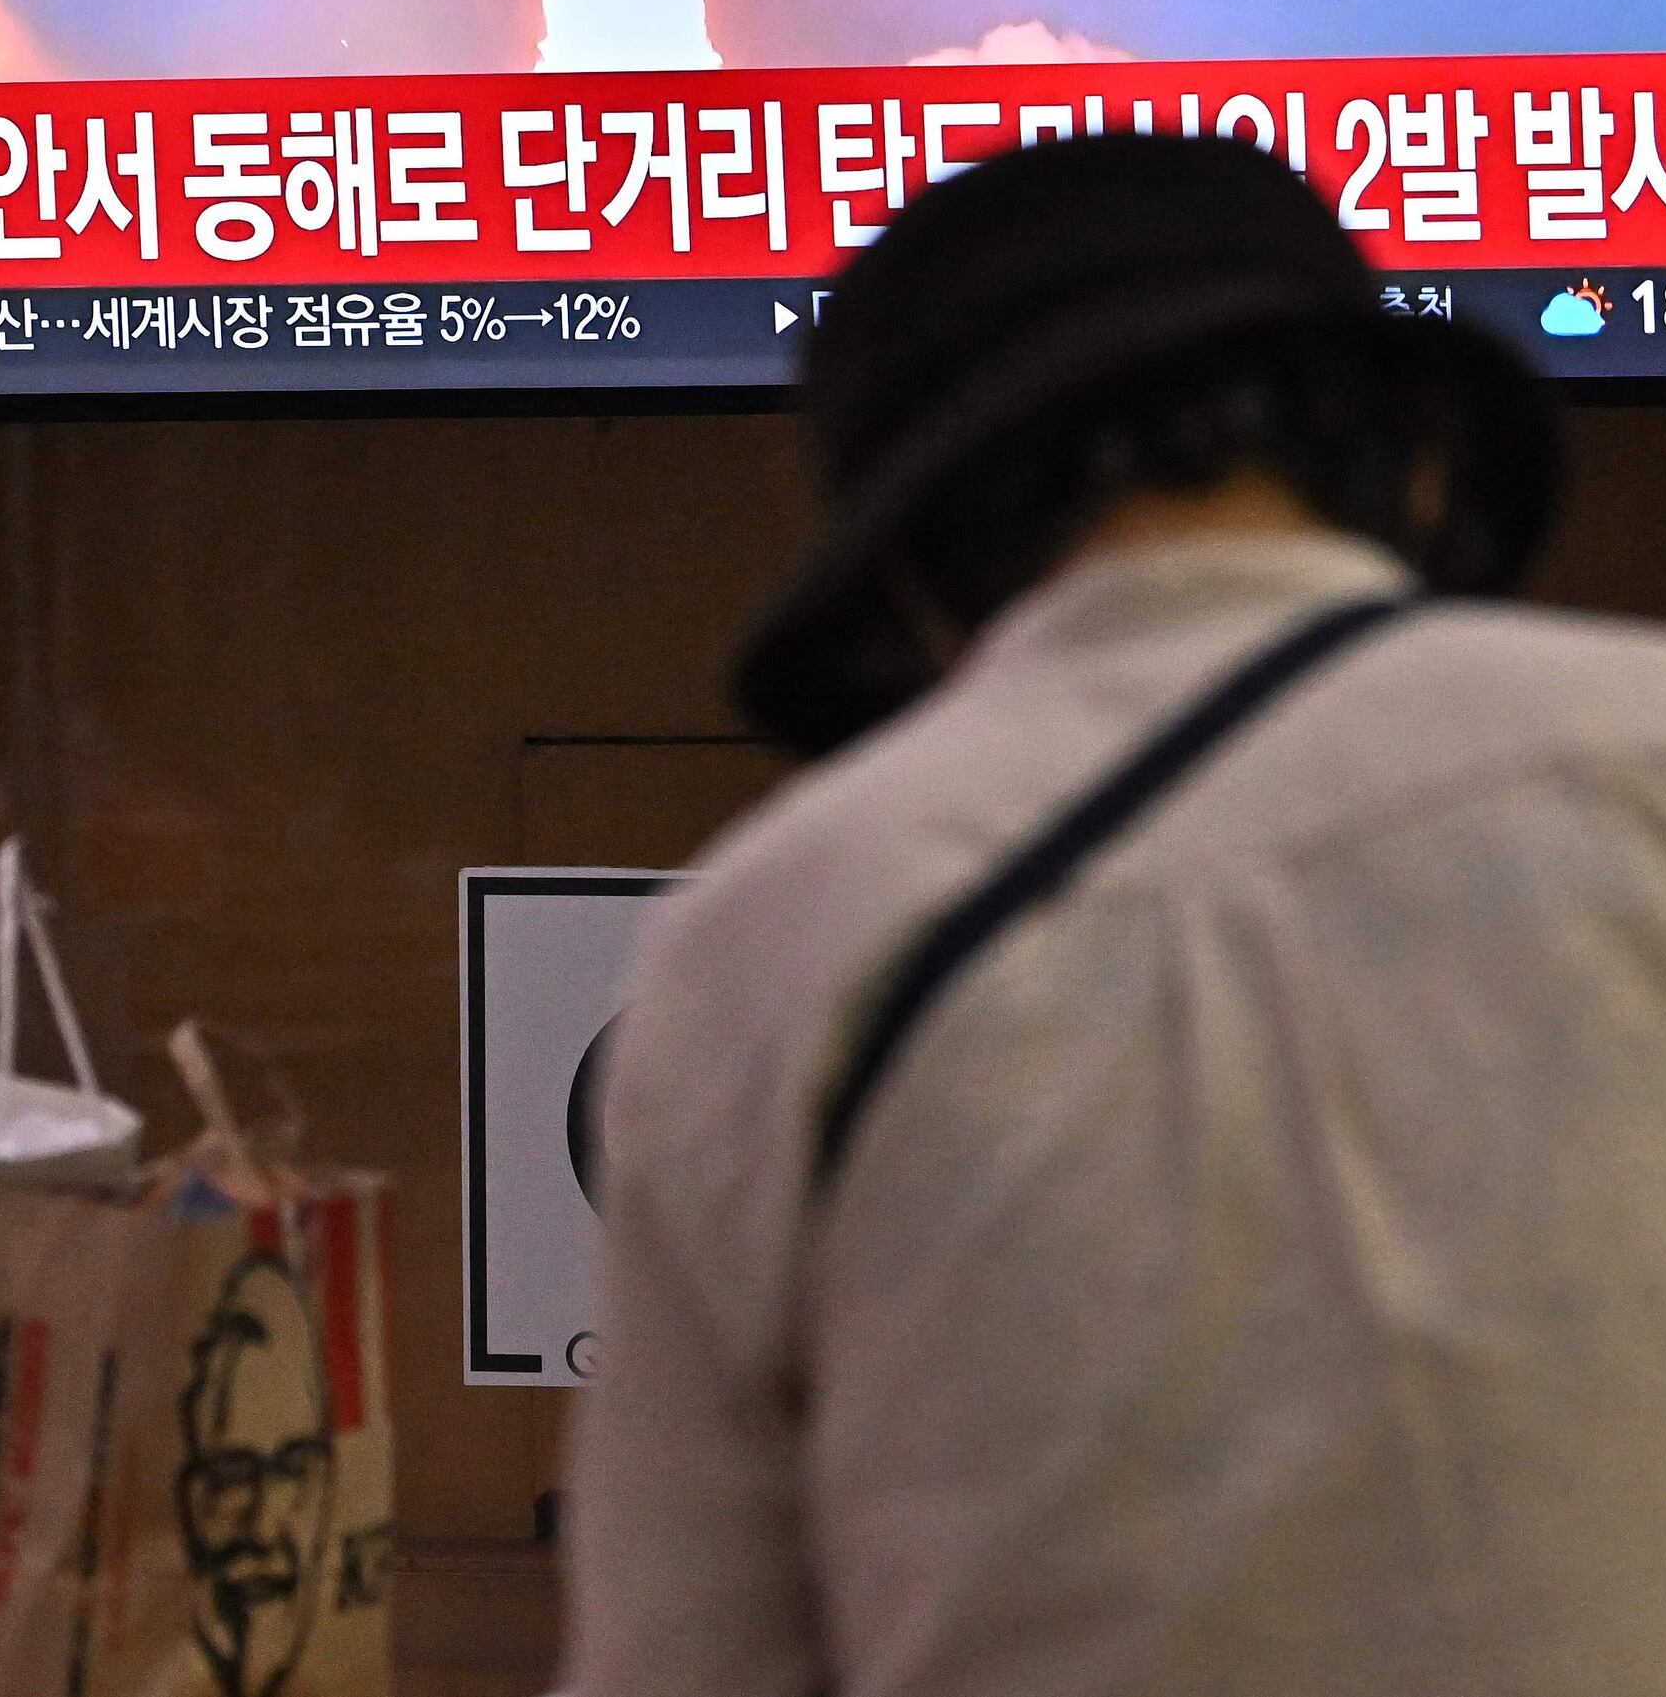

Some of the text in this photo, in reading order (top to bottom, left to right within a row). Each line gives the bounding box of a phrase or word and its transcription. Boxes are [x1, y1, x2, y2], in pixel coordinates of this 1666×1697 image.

[183, 108, 478, 261] 동해로
[501, 101, 788, 252] 단거리
[1335, 89, 1489, 242] 2발
[285, 292, 428, 347] 점유율
